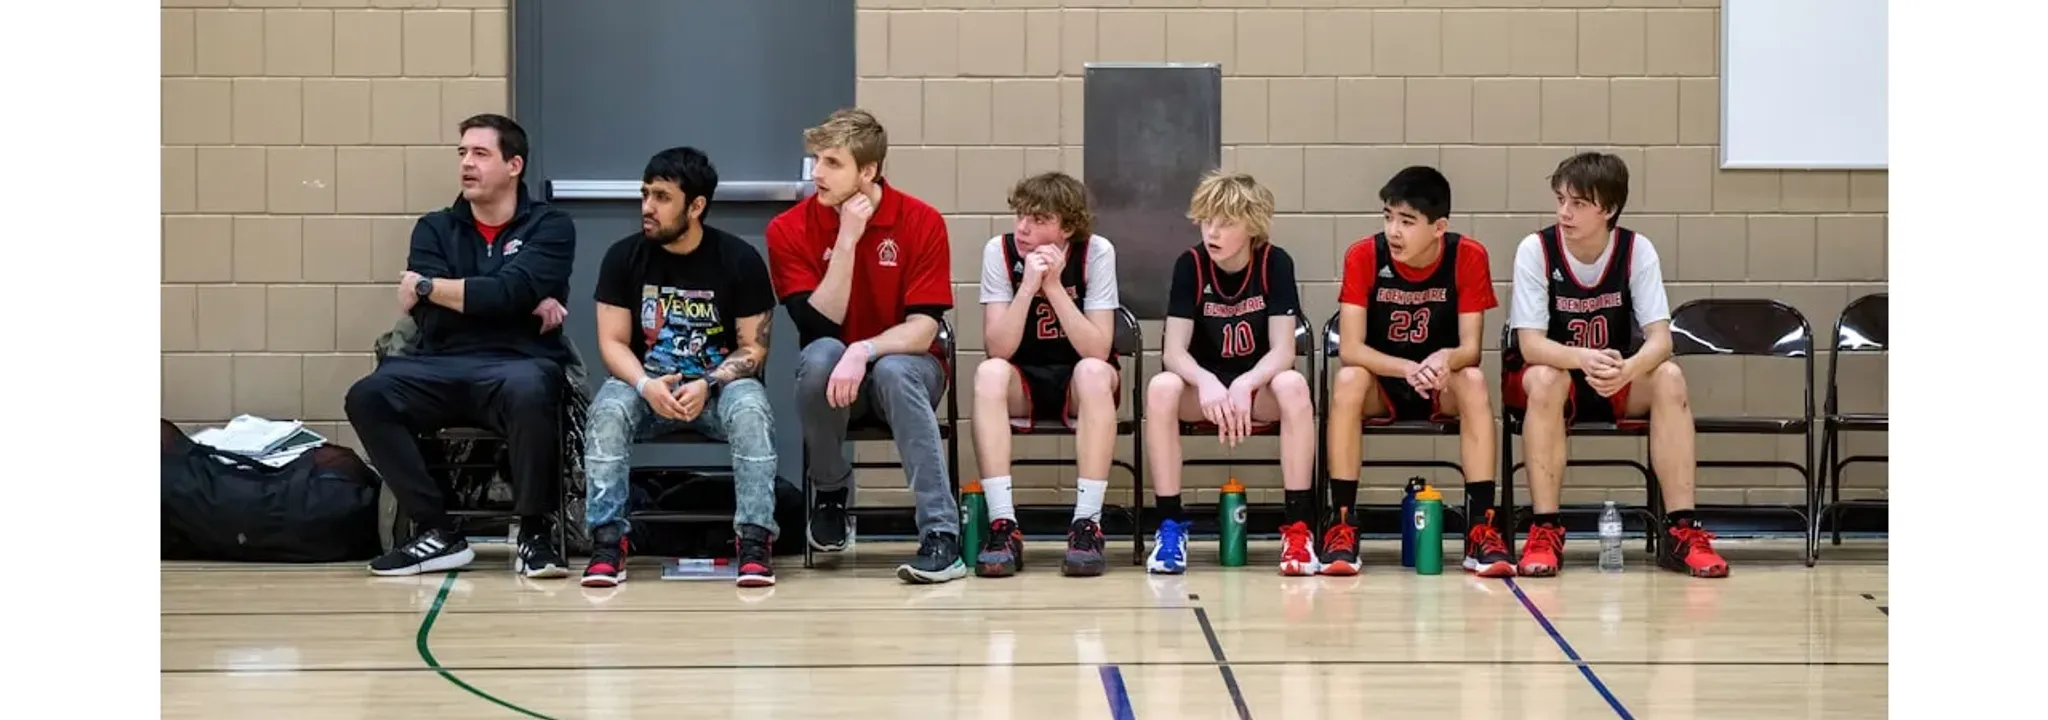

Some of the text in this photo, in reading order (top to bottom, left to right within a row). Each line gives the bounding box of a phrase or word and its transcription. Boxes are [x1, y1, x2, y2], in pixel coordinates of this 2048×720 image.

[660, 293, 718, 322] VENOM
[1036, 303, 1067, 339] 2
[1221, 320, 1255, 358] 10
[1388, 307, 1431, 343] 23
[1566, 315, 1609, 349] 30
[1234, 505, 1247, 524] G
[1414, 510, 1426, 530] G
